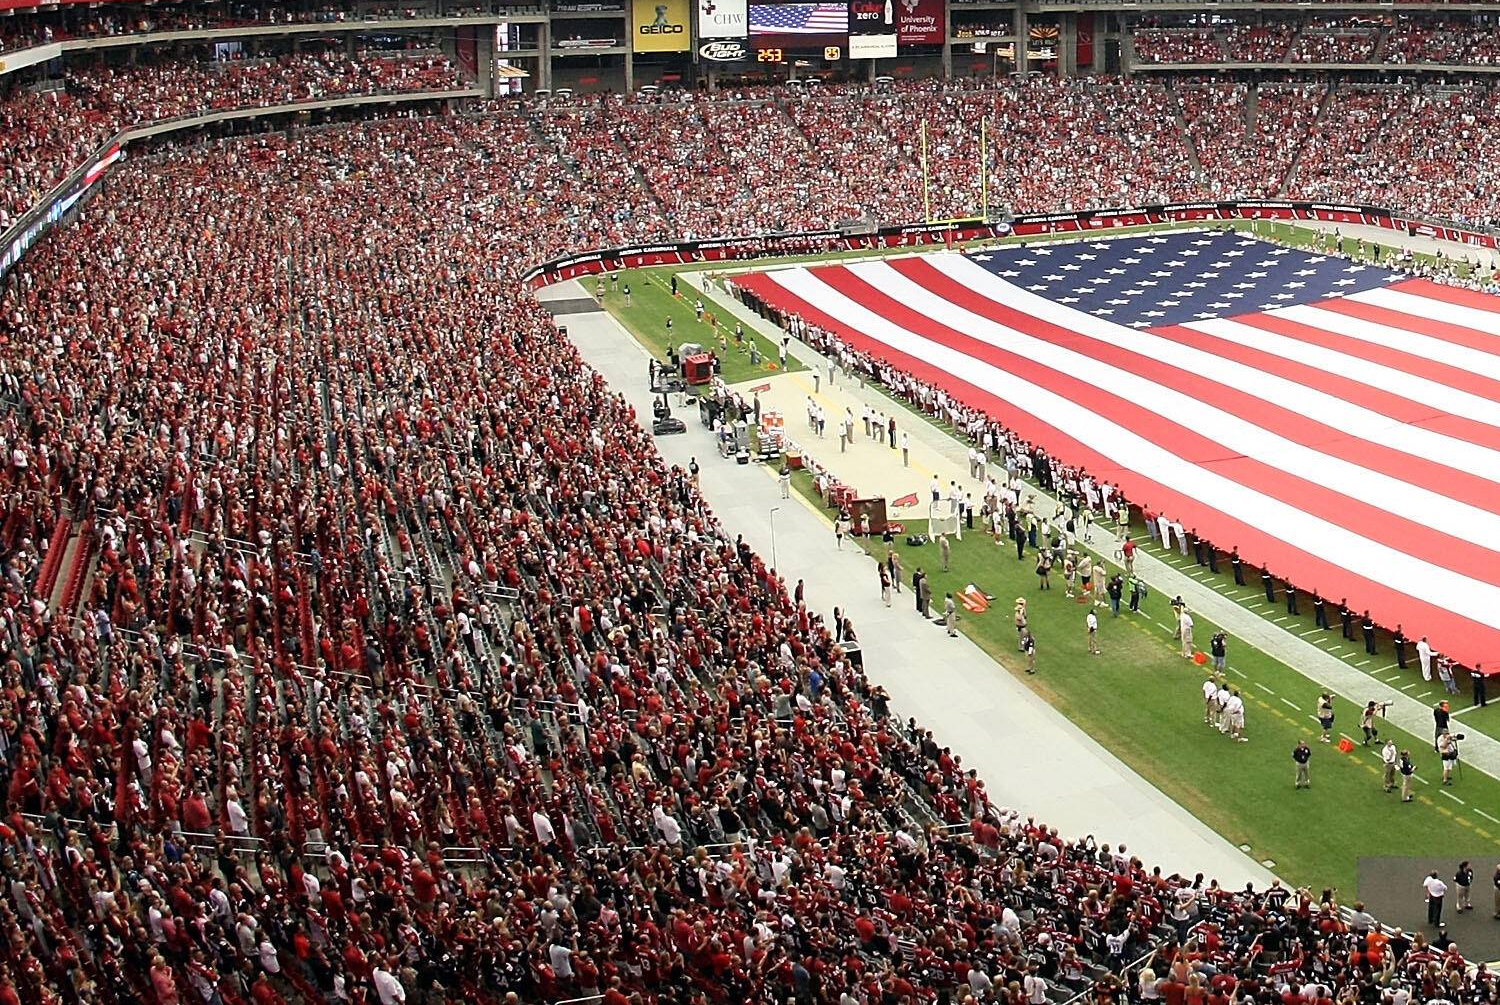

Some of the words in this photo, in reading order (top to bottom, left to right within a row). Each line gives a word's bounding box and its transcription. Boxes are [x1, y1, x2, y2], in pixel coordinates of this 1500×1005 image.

[852, 1, 883, 13] Coke
[714, 14, 744, 24] CHW
[901, 16, 935, 24] University
[640, 25, 683, 34] GEICO
[910, 25, 937, 33] Phoenix
[710, 42, 741, 51] BUD
[706, 49, 745, 58] LIGHT
[758, 49, 782, 62] 2:53
[1015, 895, 1022, 906] 11
[1057, 895, 1068, 906] 26
[1274, 897, 1282, 907] 11
[1143, 904, 1151, 916] 11
[1091, 936, 1098, 947] 11
[1224, 934, 1239, 946] 24
[930, 970, 944, 980] 26
